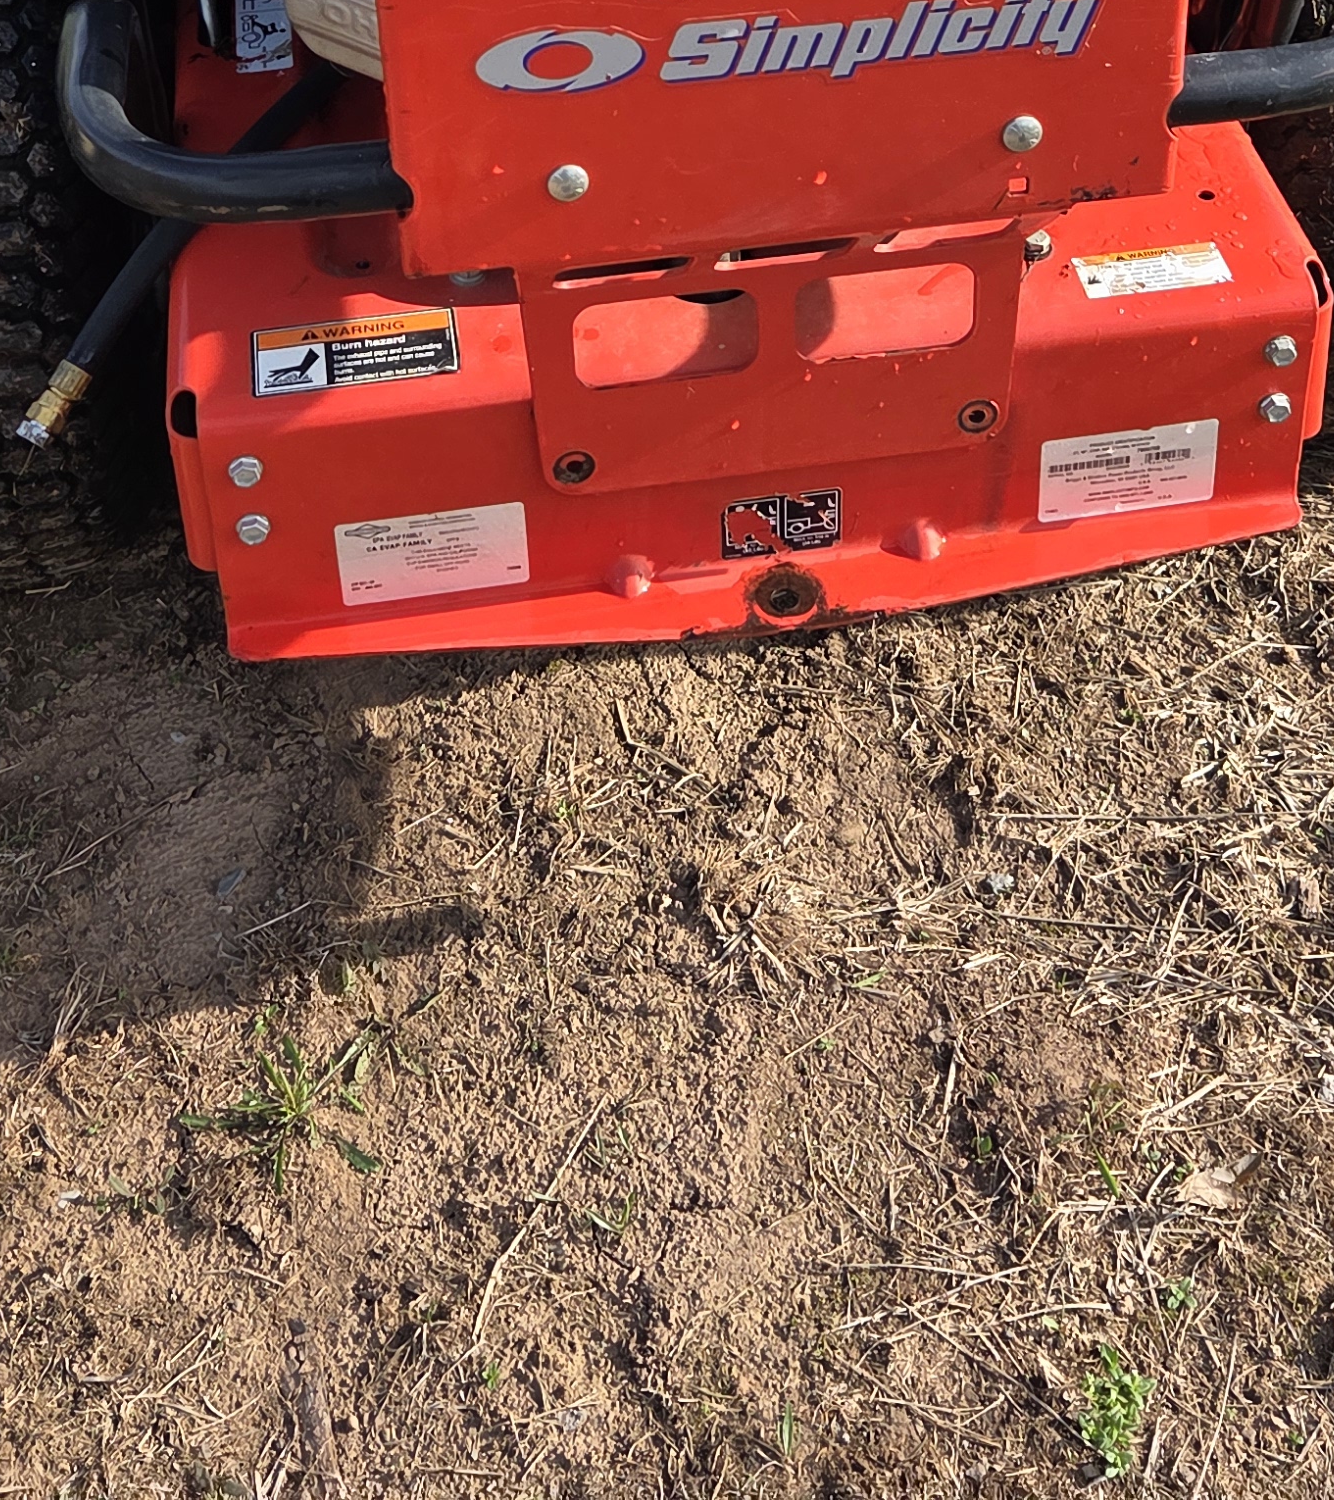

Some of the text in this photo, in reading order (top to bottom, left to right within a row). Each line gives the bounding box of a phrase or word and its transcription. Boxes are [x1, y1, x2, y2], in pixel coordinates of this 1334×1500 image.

[322, 320, 405, 338] WARNING
[331, 334, 406, 351] Burn hazard
[402, 538, 433, 547] FAMILY
